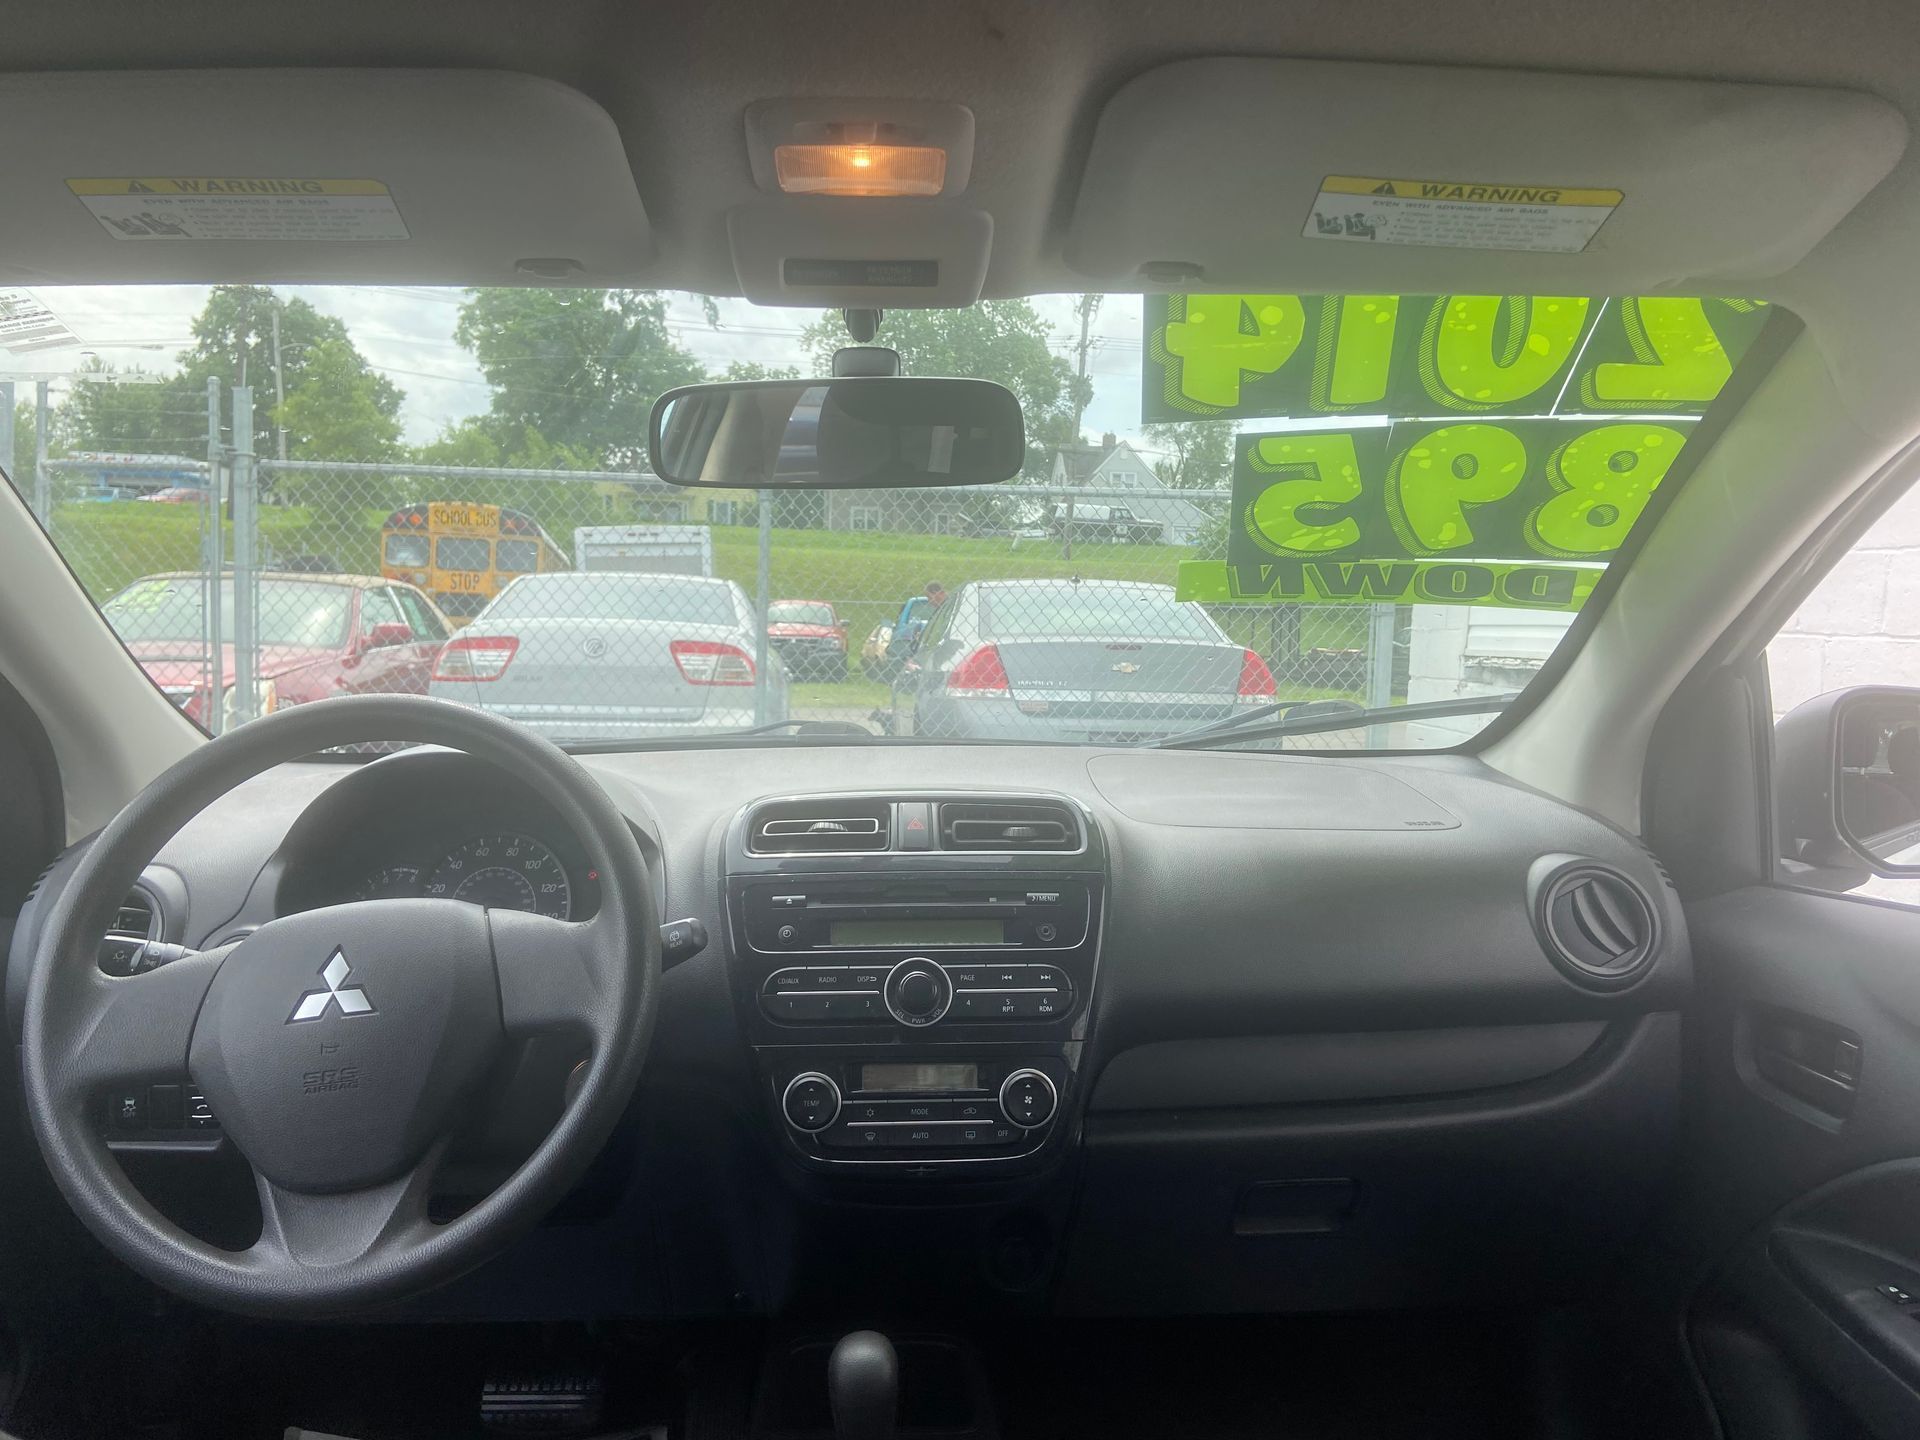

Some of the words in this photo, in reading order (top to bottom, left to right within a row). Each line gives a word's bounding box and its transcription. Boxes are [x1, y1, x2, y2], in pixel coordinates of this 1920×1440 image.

[171, 179, 325, 194] WARNING
[1421, 183, 1563, 203] WARNING
[1435, 203, 1493, 212] ADVANCED
[433, 508, 473, 526] SCHOOL
[476, 511, 497, 528] BUS
[450, 573, 480, 590] STOP
[475, 848, 490, 856] 60
[506, 848, 520, 856] 80
[450, 861, 463, 870] 40
[524, 860, 542, 869] 100
[431, 883, 446, 893] 20
[541, 883, 557, 893] 120
[911, 1107, 929, 1116] MODE
